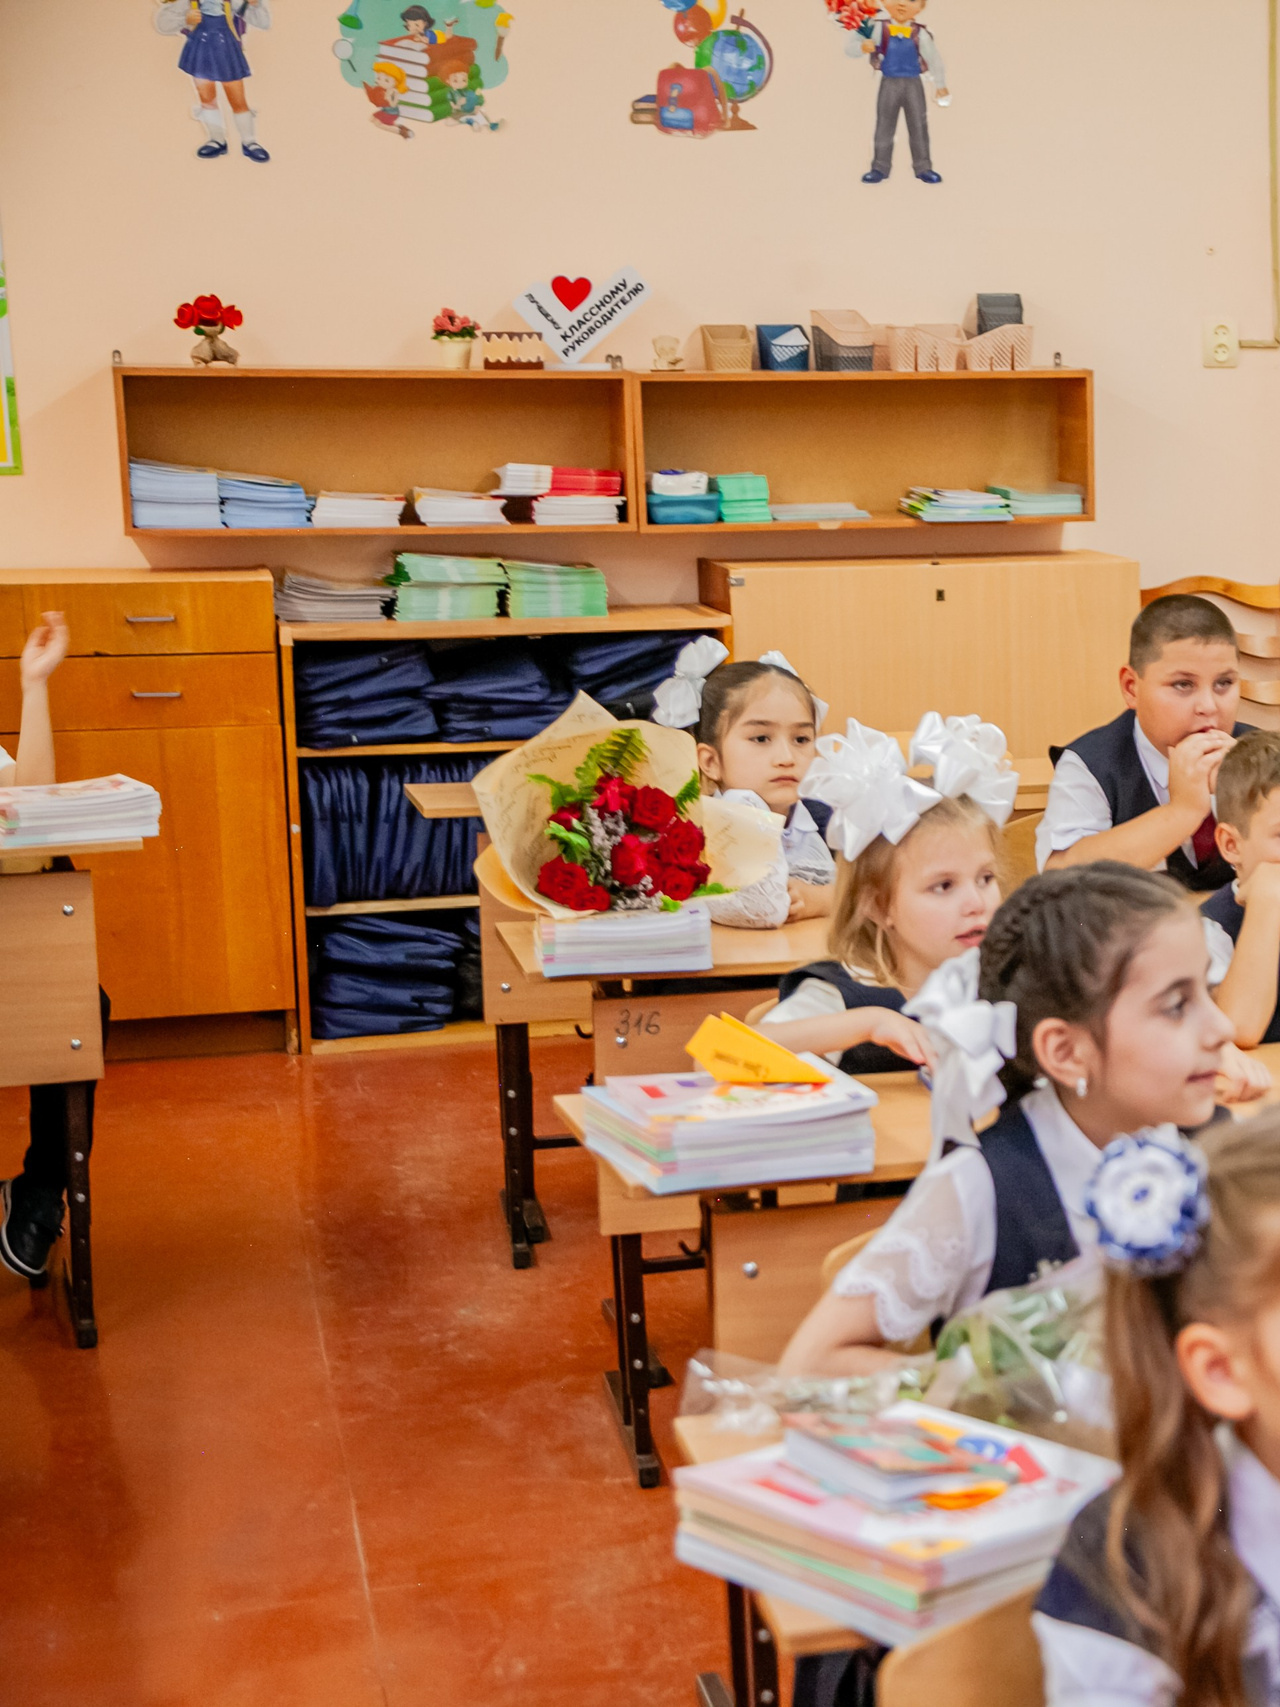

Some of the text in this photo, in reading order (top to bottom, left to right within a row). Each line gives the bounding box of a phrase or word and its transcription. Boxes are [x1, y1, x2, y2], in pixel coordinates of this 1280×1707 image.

[560, 278, 628, 342] КЛАССНОМУ
[562, 282, 645, 357] РУКОВОДИТЕЛЮ
[615, 1009, 661, 1036] 316
